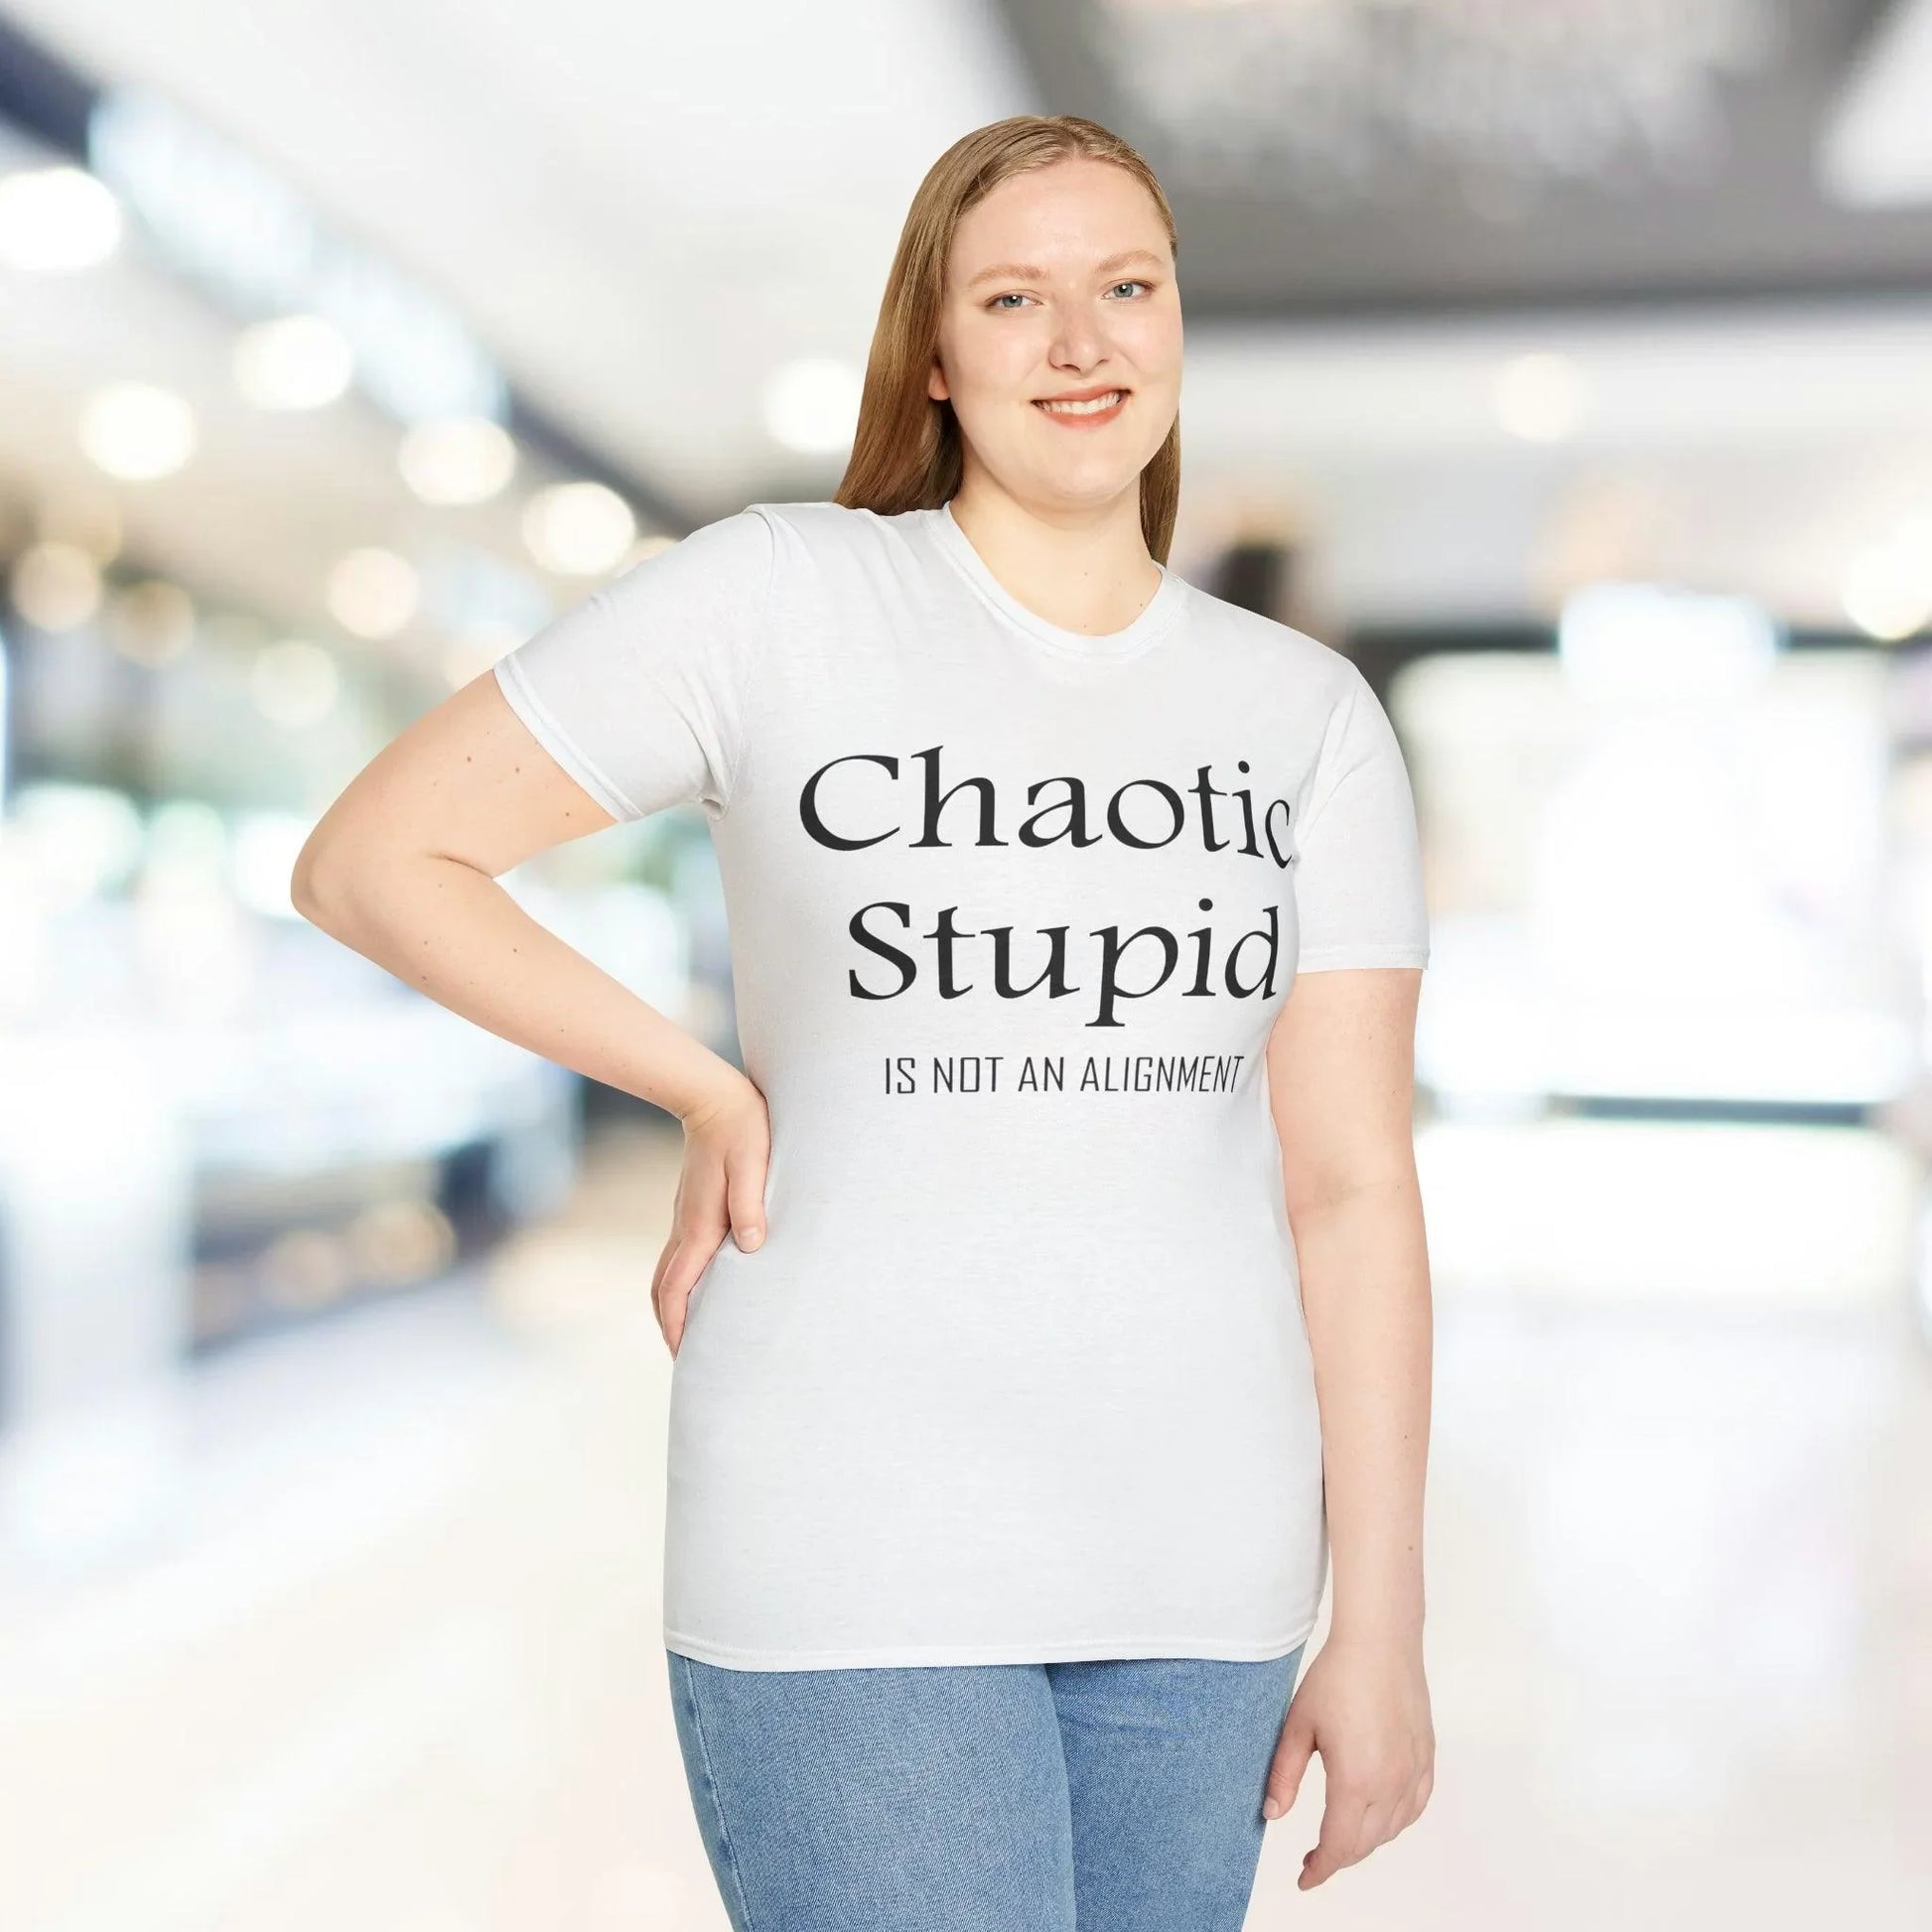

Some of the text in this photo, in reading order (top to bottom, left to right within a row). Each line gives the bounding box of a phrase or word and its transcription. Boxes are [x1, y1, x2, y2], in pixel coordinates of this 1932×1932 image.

[799, 745, 1293, 870] Chaotic
[848, 897, 1279, 1028] Stupid
[886, 1055, 1245, 1094] IS NOT AN ALIGNMENT
